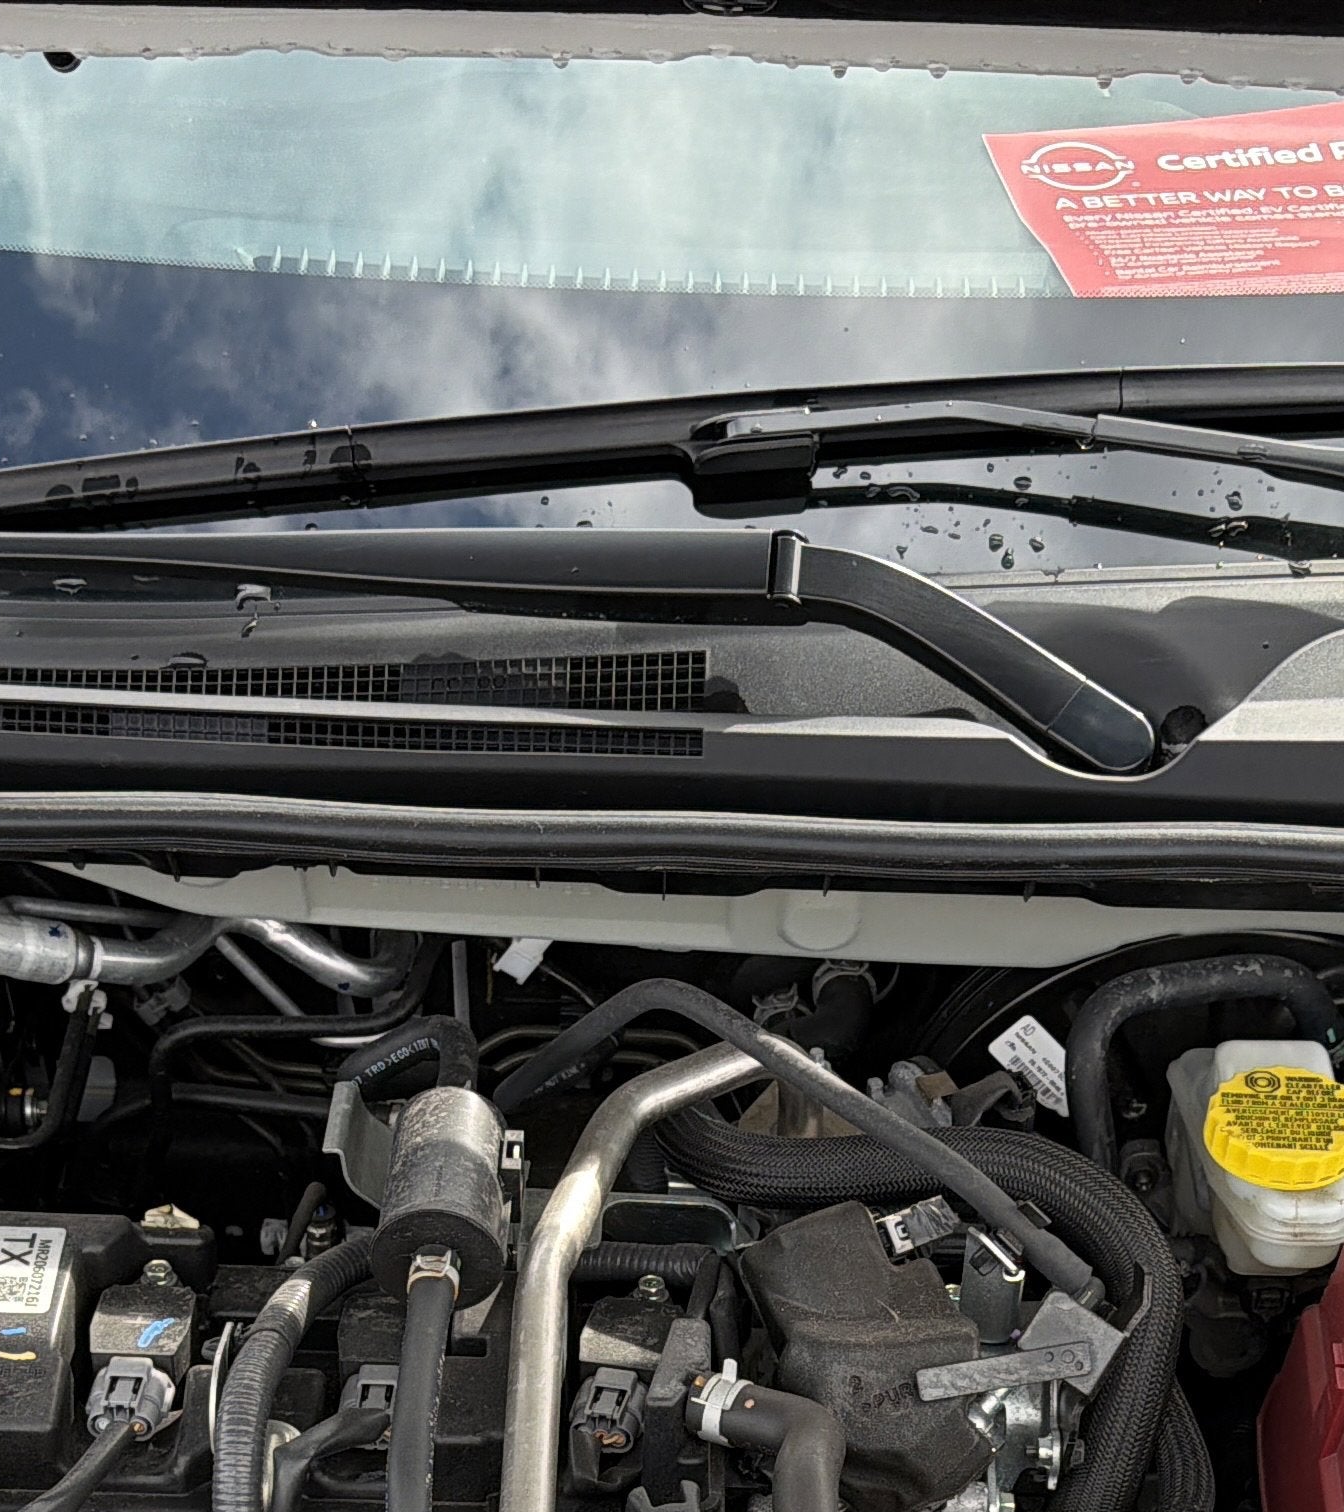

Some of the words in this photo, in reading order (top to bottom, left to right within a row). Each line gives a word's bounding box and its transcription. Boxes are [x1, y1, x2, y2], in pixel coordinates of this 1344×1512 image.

[1157, 143, 1323, 170] Certified
[1021, 161, 1134, 175] NISSAN
[1056, 199, 1078, 210] A
[1082, 192, 1200, 208] BETTER
[1203, 188, 1266, 203] WAY
[1272, 186, 1317, 199] TO
[1116, 211, 1175, 221] Nissan
